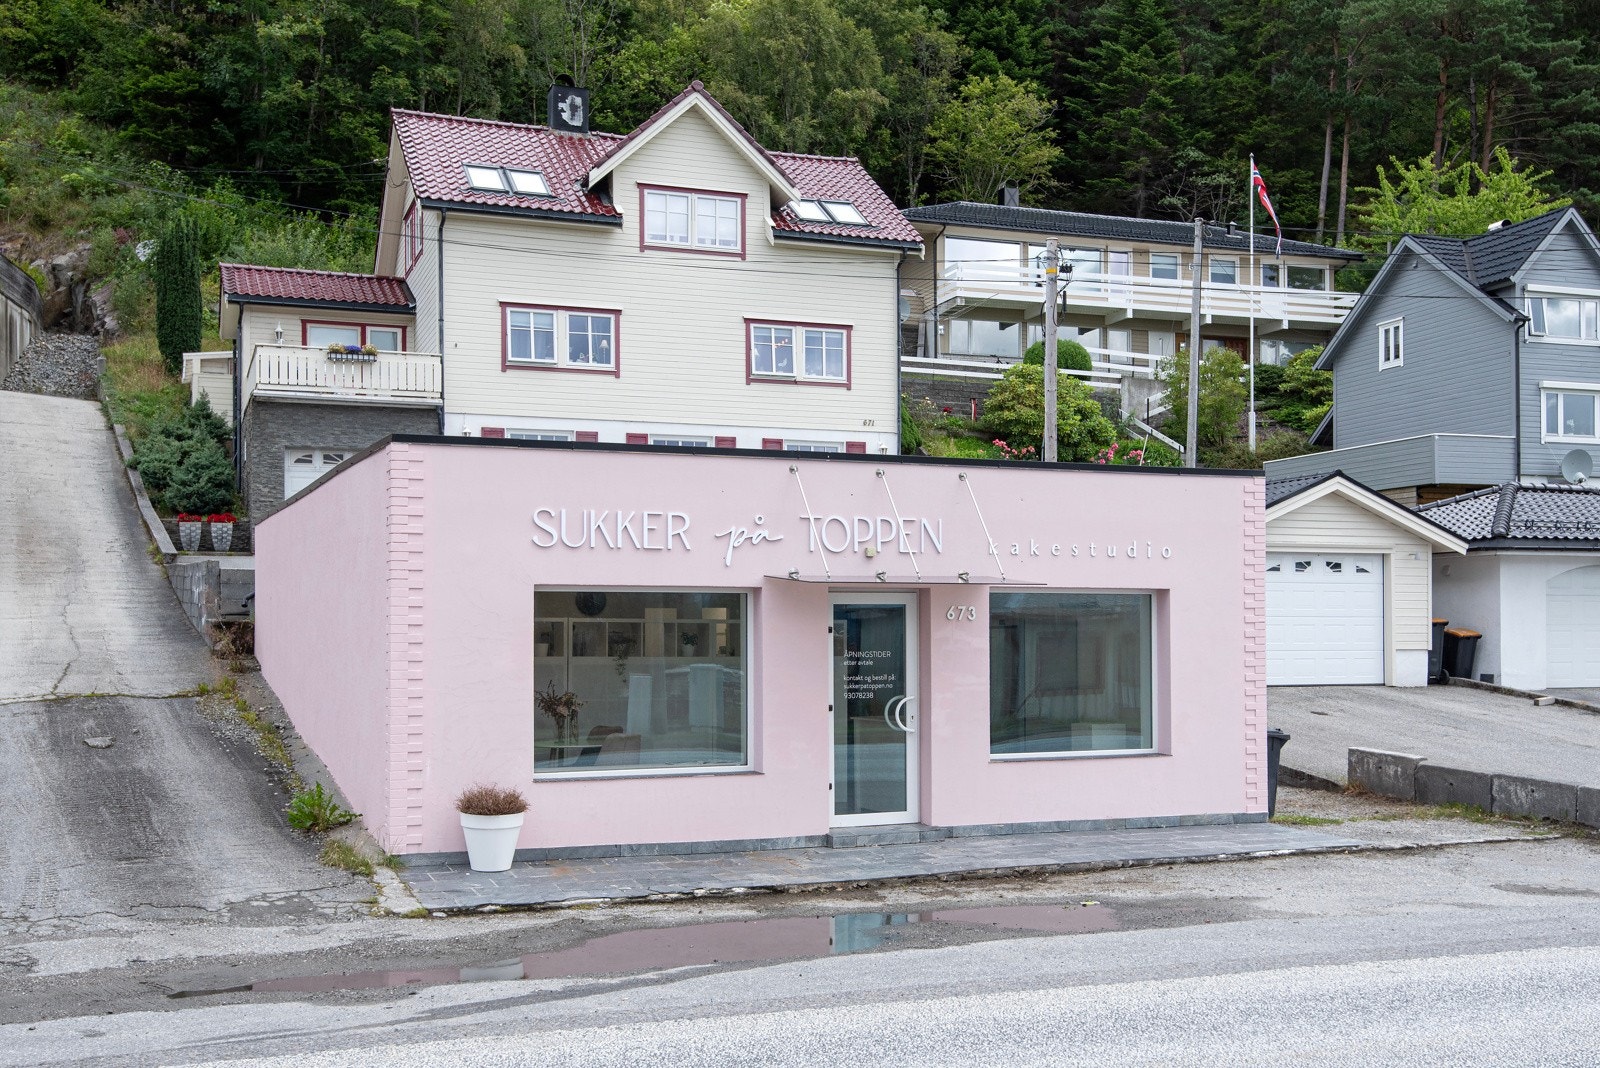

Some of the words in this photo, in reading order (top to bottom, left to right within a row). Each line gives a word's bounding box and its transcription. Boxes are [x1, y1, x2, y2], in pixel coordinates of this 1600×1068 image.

[863, 419, 875, 427] 671
[531, 507, 692, 551] SUKKER
[714, 514, 784, 567] på
[800, 514, 943, 554] TOPPEN
[989, 538, 1172, 559] kakestudio
[946, 605, 976, 621] 673
[843, 650, 891, 658] ÅPNINGSTIDER
